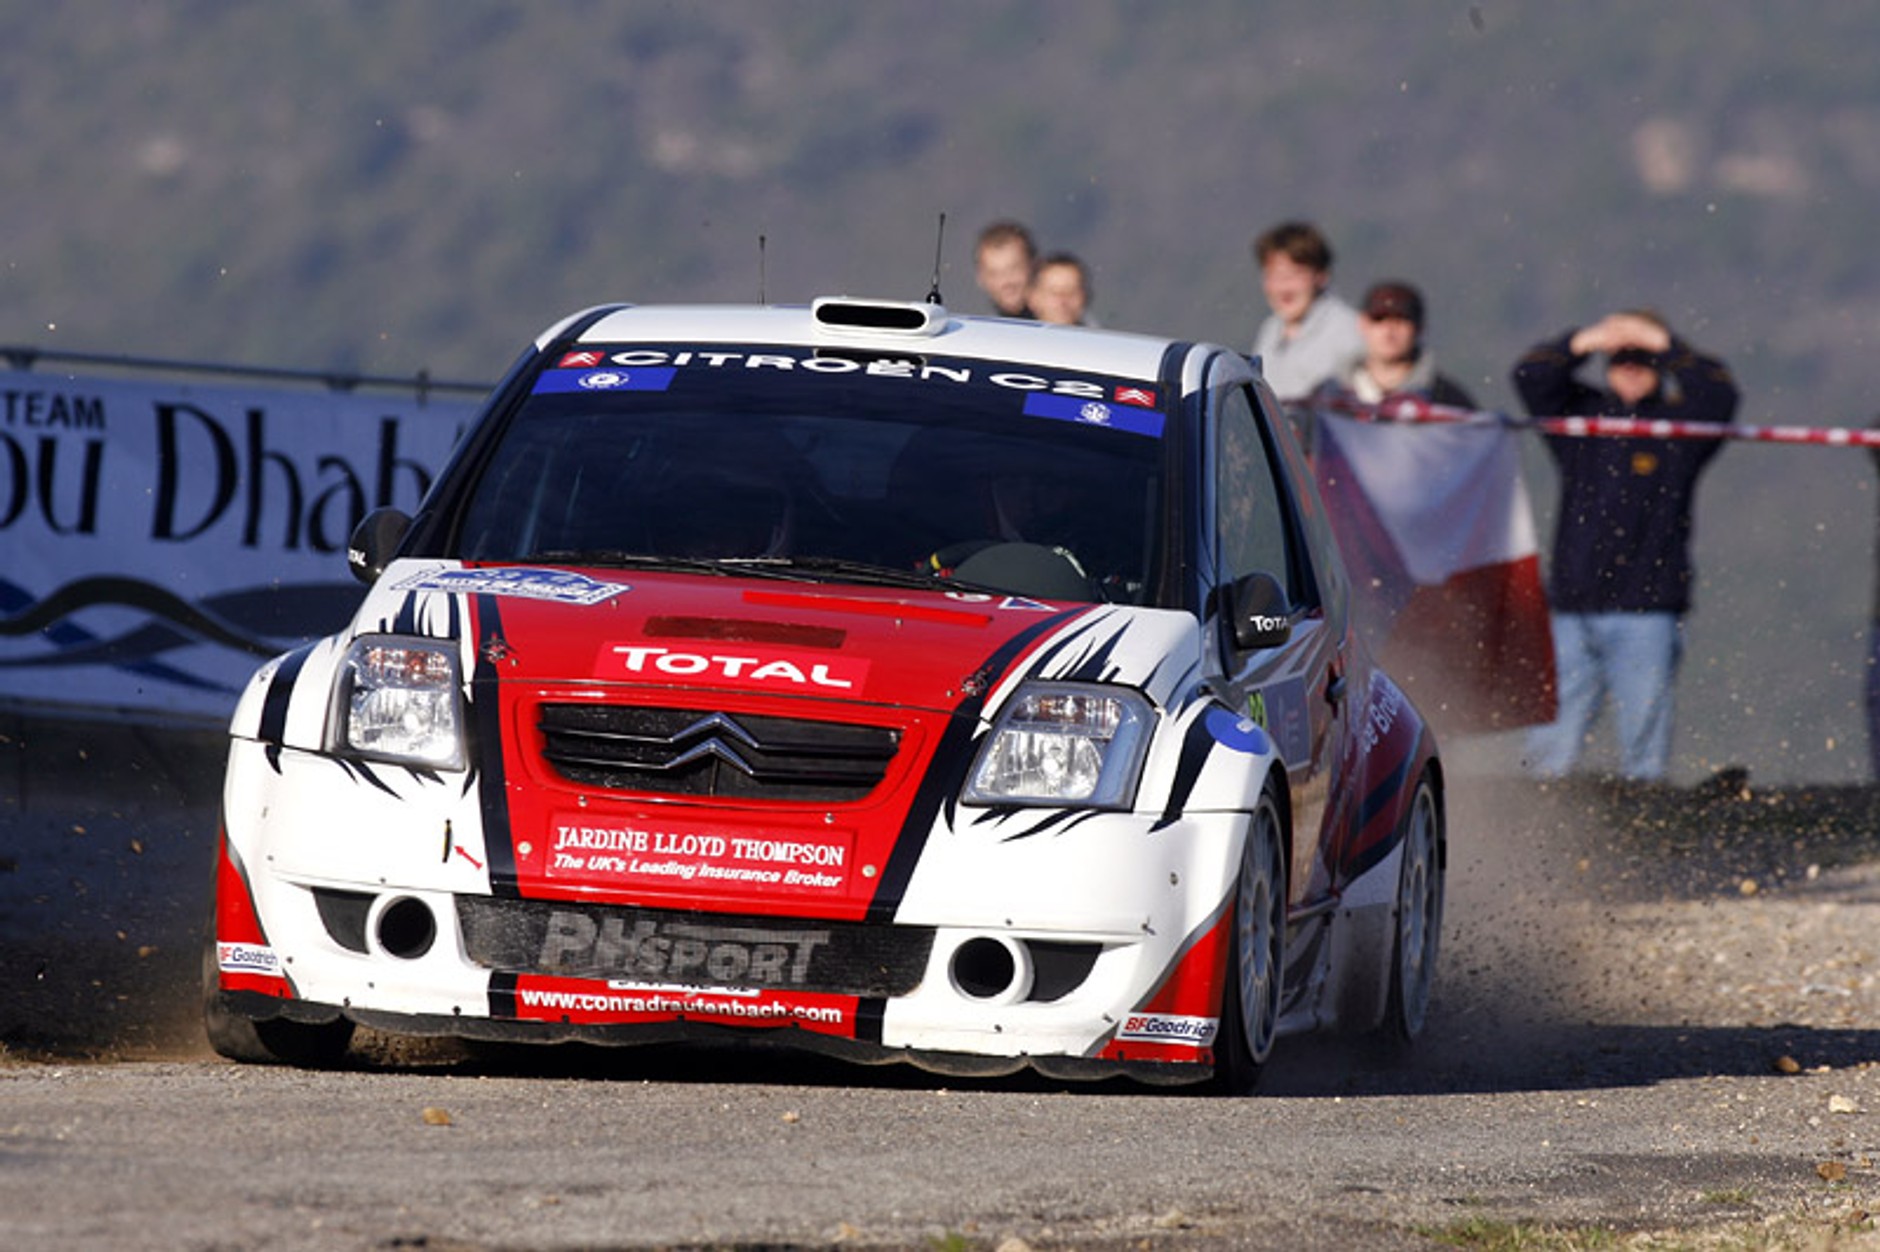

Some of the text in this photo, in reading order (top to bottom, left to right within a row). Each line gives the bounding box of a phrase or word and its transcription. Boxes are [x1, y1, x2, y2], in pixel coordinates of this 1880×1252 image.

[989, 373, 1105, 399] C2
[3, 390, 106, 431] TEAM
[152, 400, 467, 554] Dhab
[612, 645, 853, 689] TOTAL
[553, 826, 846, 867] JARDINE LLOYD THOMPSON
[553, 853, 843, 888] The UK's Leading Insurance Broker
[521, 988, 844, 1024] www.conradrautenbach.com
[1123, 1016, 1216, 1038] BFGoodrich
